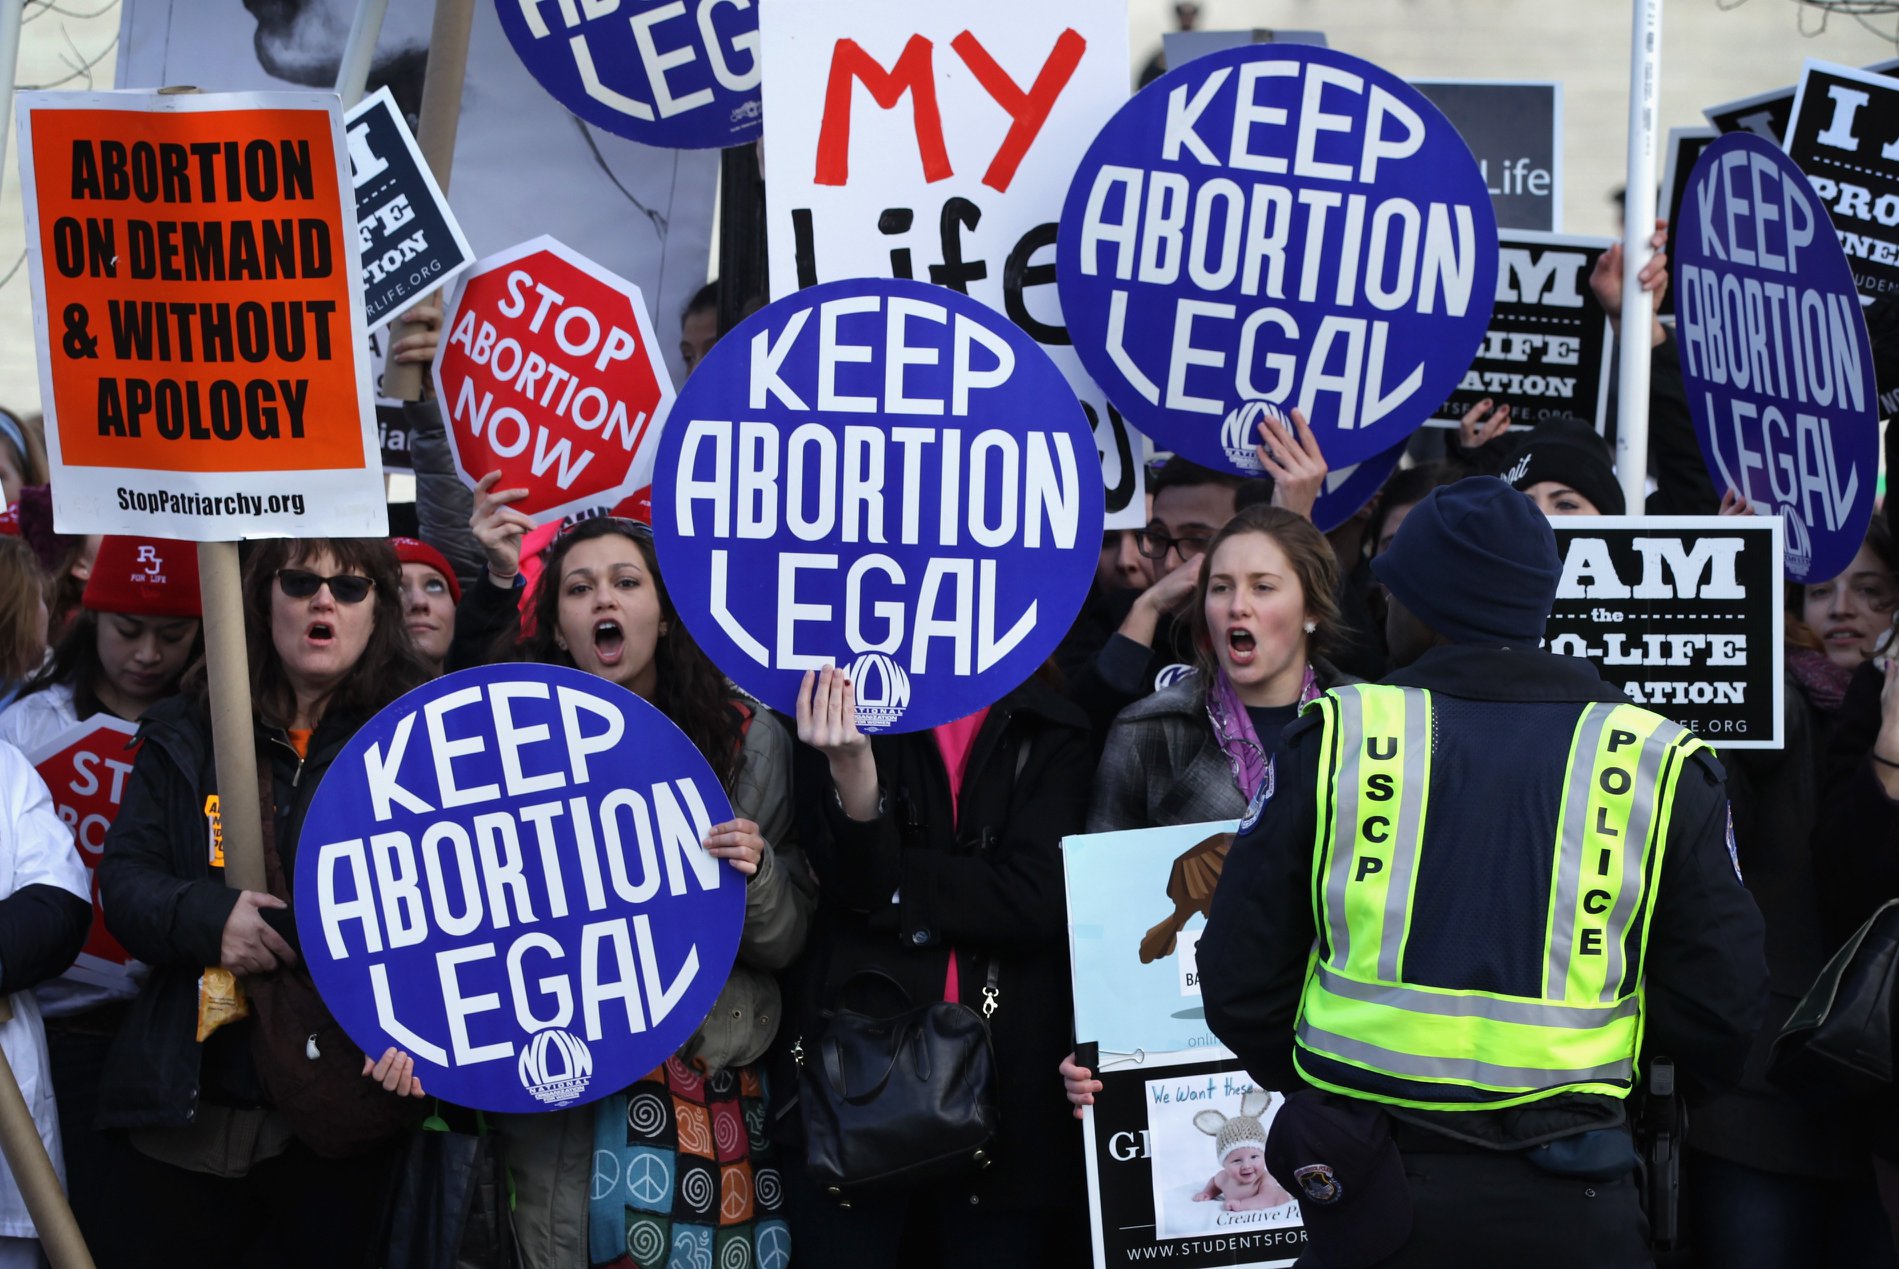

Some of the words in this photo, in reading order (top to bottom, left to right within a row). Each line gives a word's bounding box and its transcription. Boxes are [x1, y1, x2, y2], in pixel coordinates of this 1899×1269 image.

[813, 27, 1087, 194] MY
[1162, 60, 1426, 184] KEEP
[1817, 84, 1871, 152] I
[70, 138, 315, 204] ABORTION
[1697, 150, 1815, 274] KEEP
[53, 217, 118, 279] ON
[128, 218, 333, 282] DEMAND
[1080, 164, 1476, 318] ABORTION
[62, 303, 99, 360] &
[109, 300, 336, 363] WITHOUT
[497, 269, 636, 373] STOP
[750, 295, 1016, 417] KEEP
[1105, 289, 1426, 431] LEGAL
[1682, 264, 1866, 413] ABORTION
[97, 377, 309, 441] APOLOGY
[450, 309, 647, 452] ABORTION
[454, 375, 595, 491] NOW
[117, 487, 305, 516] StopPatriarchy.org
[675, 420, 1080, 550] ABORTION
[1706, 392, 1859, 532] LEGAL
[710, 549, 1038, 677] LEGAL
[1555, 537, 1747, 600] AM
[1591, 608, 1624, 622] the
[1539, 633, 1747, 667] O-LIFE
[363, 681, 625, 822] KEEP
[1674, 719, 1747, 733] FE.ORG
[1355, 737, 1398, 882] USCP
[1579, 729, 1638, 956] POLICE
[317, 777, 721, 961] ABORTION
[369, 913, 700, 1068] LEGAL
[518, 1029, 593, 1088] NOW
[529, 1077, 590, 1095] NATIONAL
[1151, 1086, 1171, 1105] We
[1224, 1077, 1254, 1096] these
[1127, 1230, 1309, 1261] WWW.STUDENTSFOR
[1216, 1210, 1281, 1228] Creative
